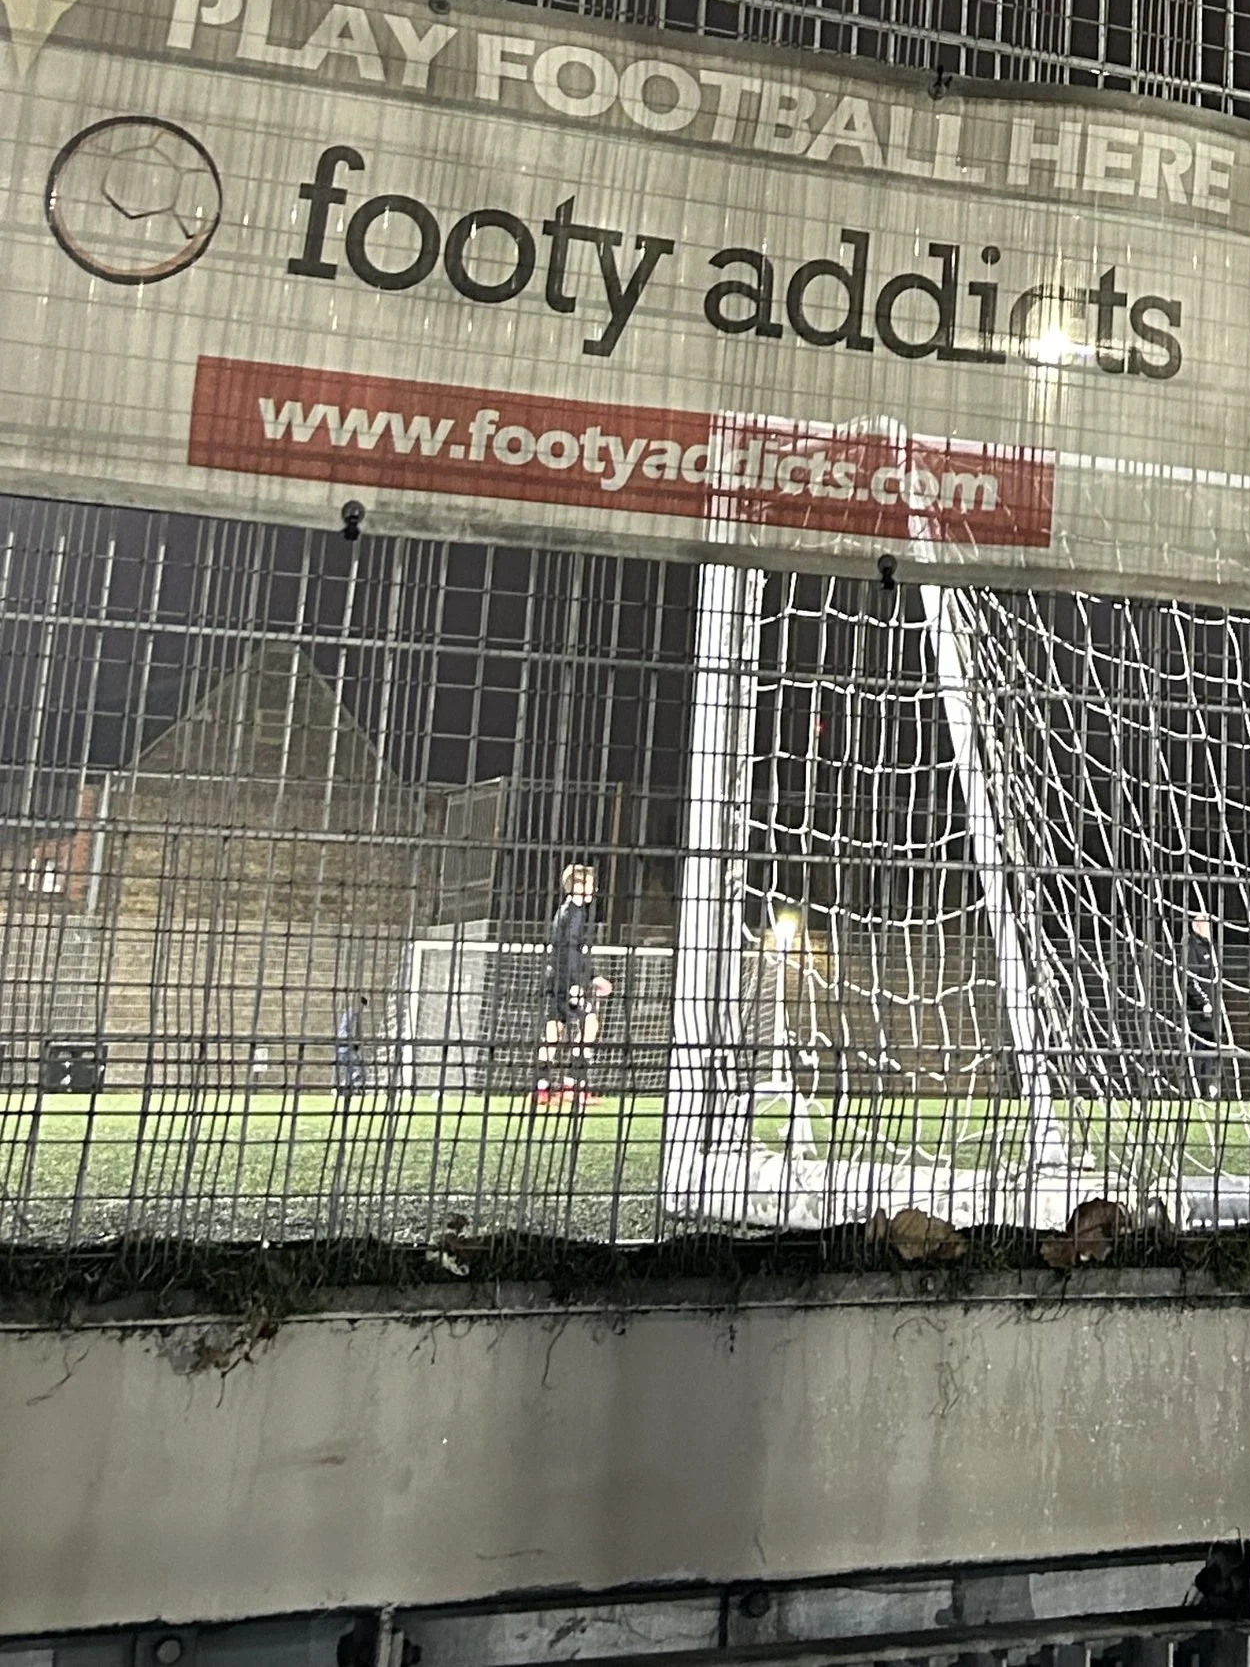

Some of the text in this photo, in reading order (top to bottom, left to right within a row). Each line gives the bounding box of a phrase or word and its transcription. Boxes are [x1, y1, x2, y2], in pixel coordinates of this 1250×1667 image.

[475, 34, 985, 185] FOOTBALL
[1007, 117, 1235, 214] HERE
[287, 145, 1182, 380] footy addicts
[258, 396, 999, 512] www.footyaddicts.com
